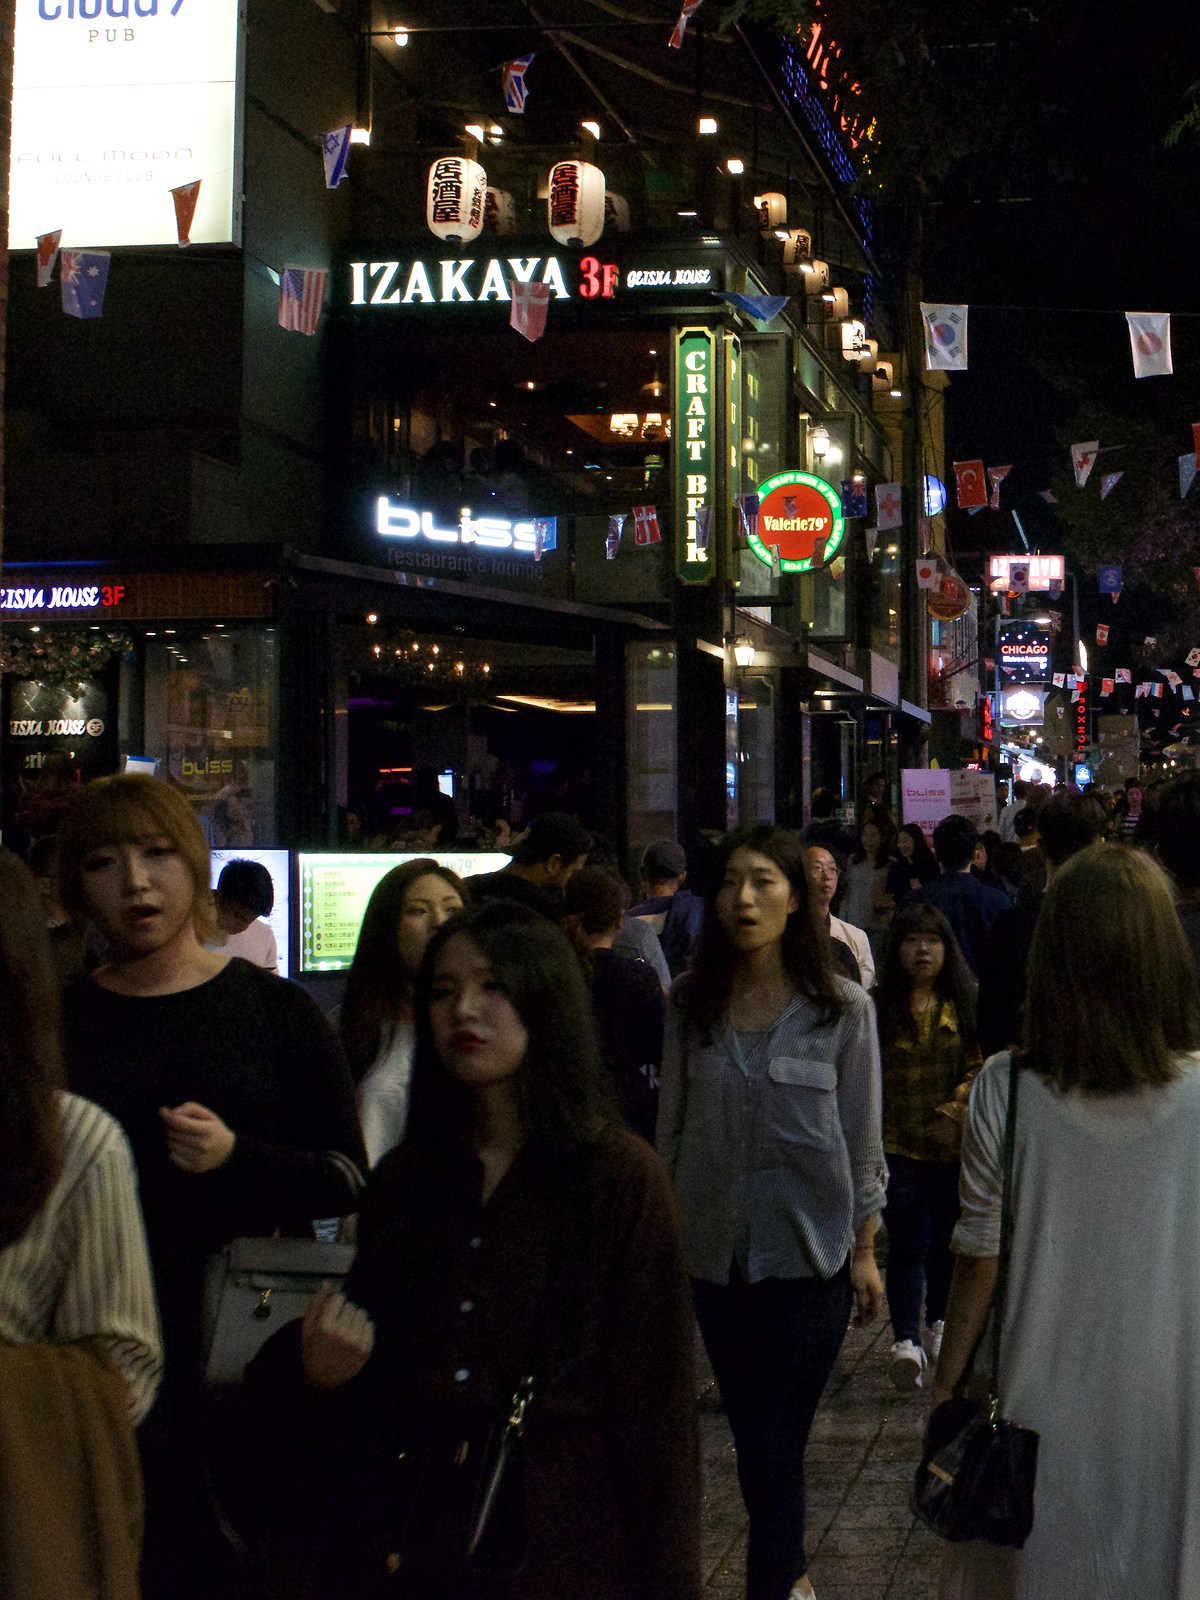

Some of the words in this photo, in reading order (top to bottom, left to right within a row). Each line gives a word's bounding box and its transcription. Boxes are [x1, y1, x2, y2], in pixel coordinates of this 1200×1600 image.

[88, 28, 136, 43] PUB
[55, 172, 111, 184] LOUNGE
[116, 170, 153, 183] CLUB
[432, 158, 463, 225] 居酒屋
[551, 163, 579, 228] 居酒屋
[349, 256, 572, 305] IZAKAYA
[579, 255, 619, 299] 3F
[626, 270, 672, 288] GEISHA
[672, 268, 712, 286] HOUSE
[685, 351, 708, 461] CRAFT
[377, 496, 547, 552] bliss
[387, 548, 472, 572] restaurant
[992, 558, 1060, 577] IZAYA
[47, 586, 99, 609] HOUSE
[101, 585, 125, 607] 3F
[1001, 645, 1048, 655] CHICAGO
[45, 718, 87, 736] HOUSE
[90, 723, 101, 733] 3F
[181, 757, 233, 777] bliss
[906, 787, 946, 797] bliss
